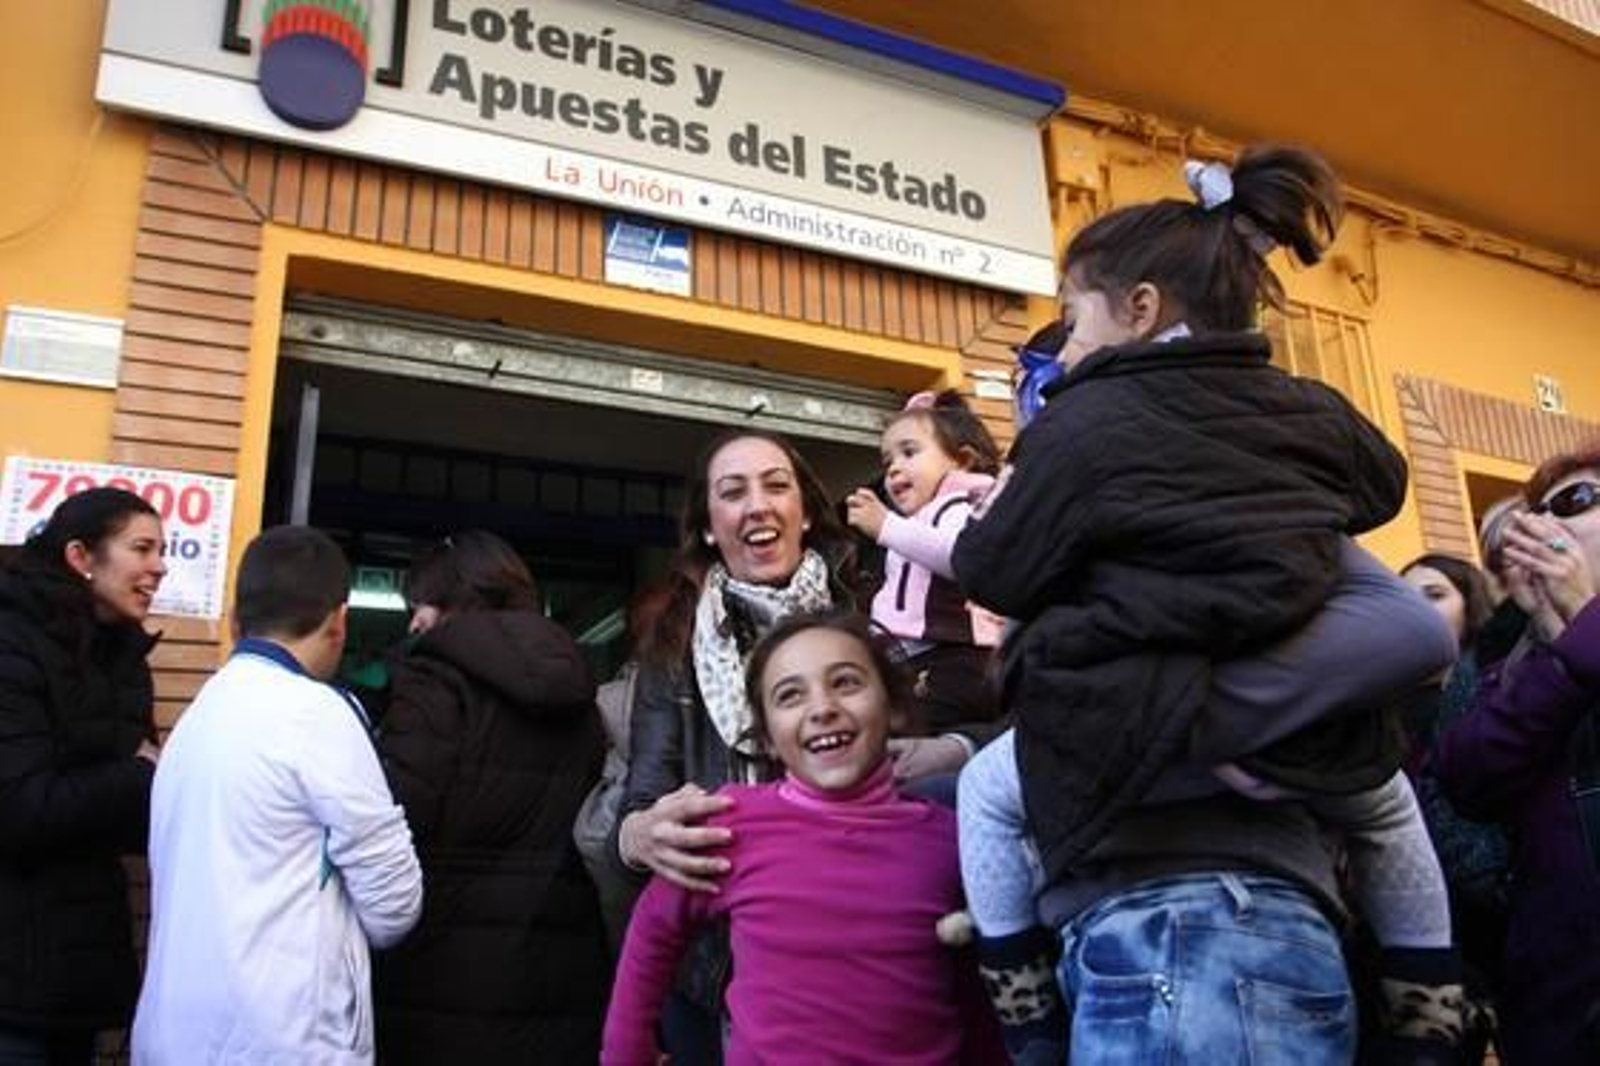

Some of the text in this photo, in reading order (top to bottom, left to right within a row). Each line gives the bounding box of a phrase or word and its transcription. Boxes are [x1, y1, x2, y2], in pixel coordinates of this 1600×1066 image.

[432, 0, 724, 108] Loterías y
[428, 52, 986, 221] Apuestas del Estado
[546, 157, 580, 185] La
[599, 167, 684, 206] Unión
[726, 196, 927, 259] Administración
[979, 251, 993, 275] 2
[26, 472, 212, 526] 700
